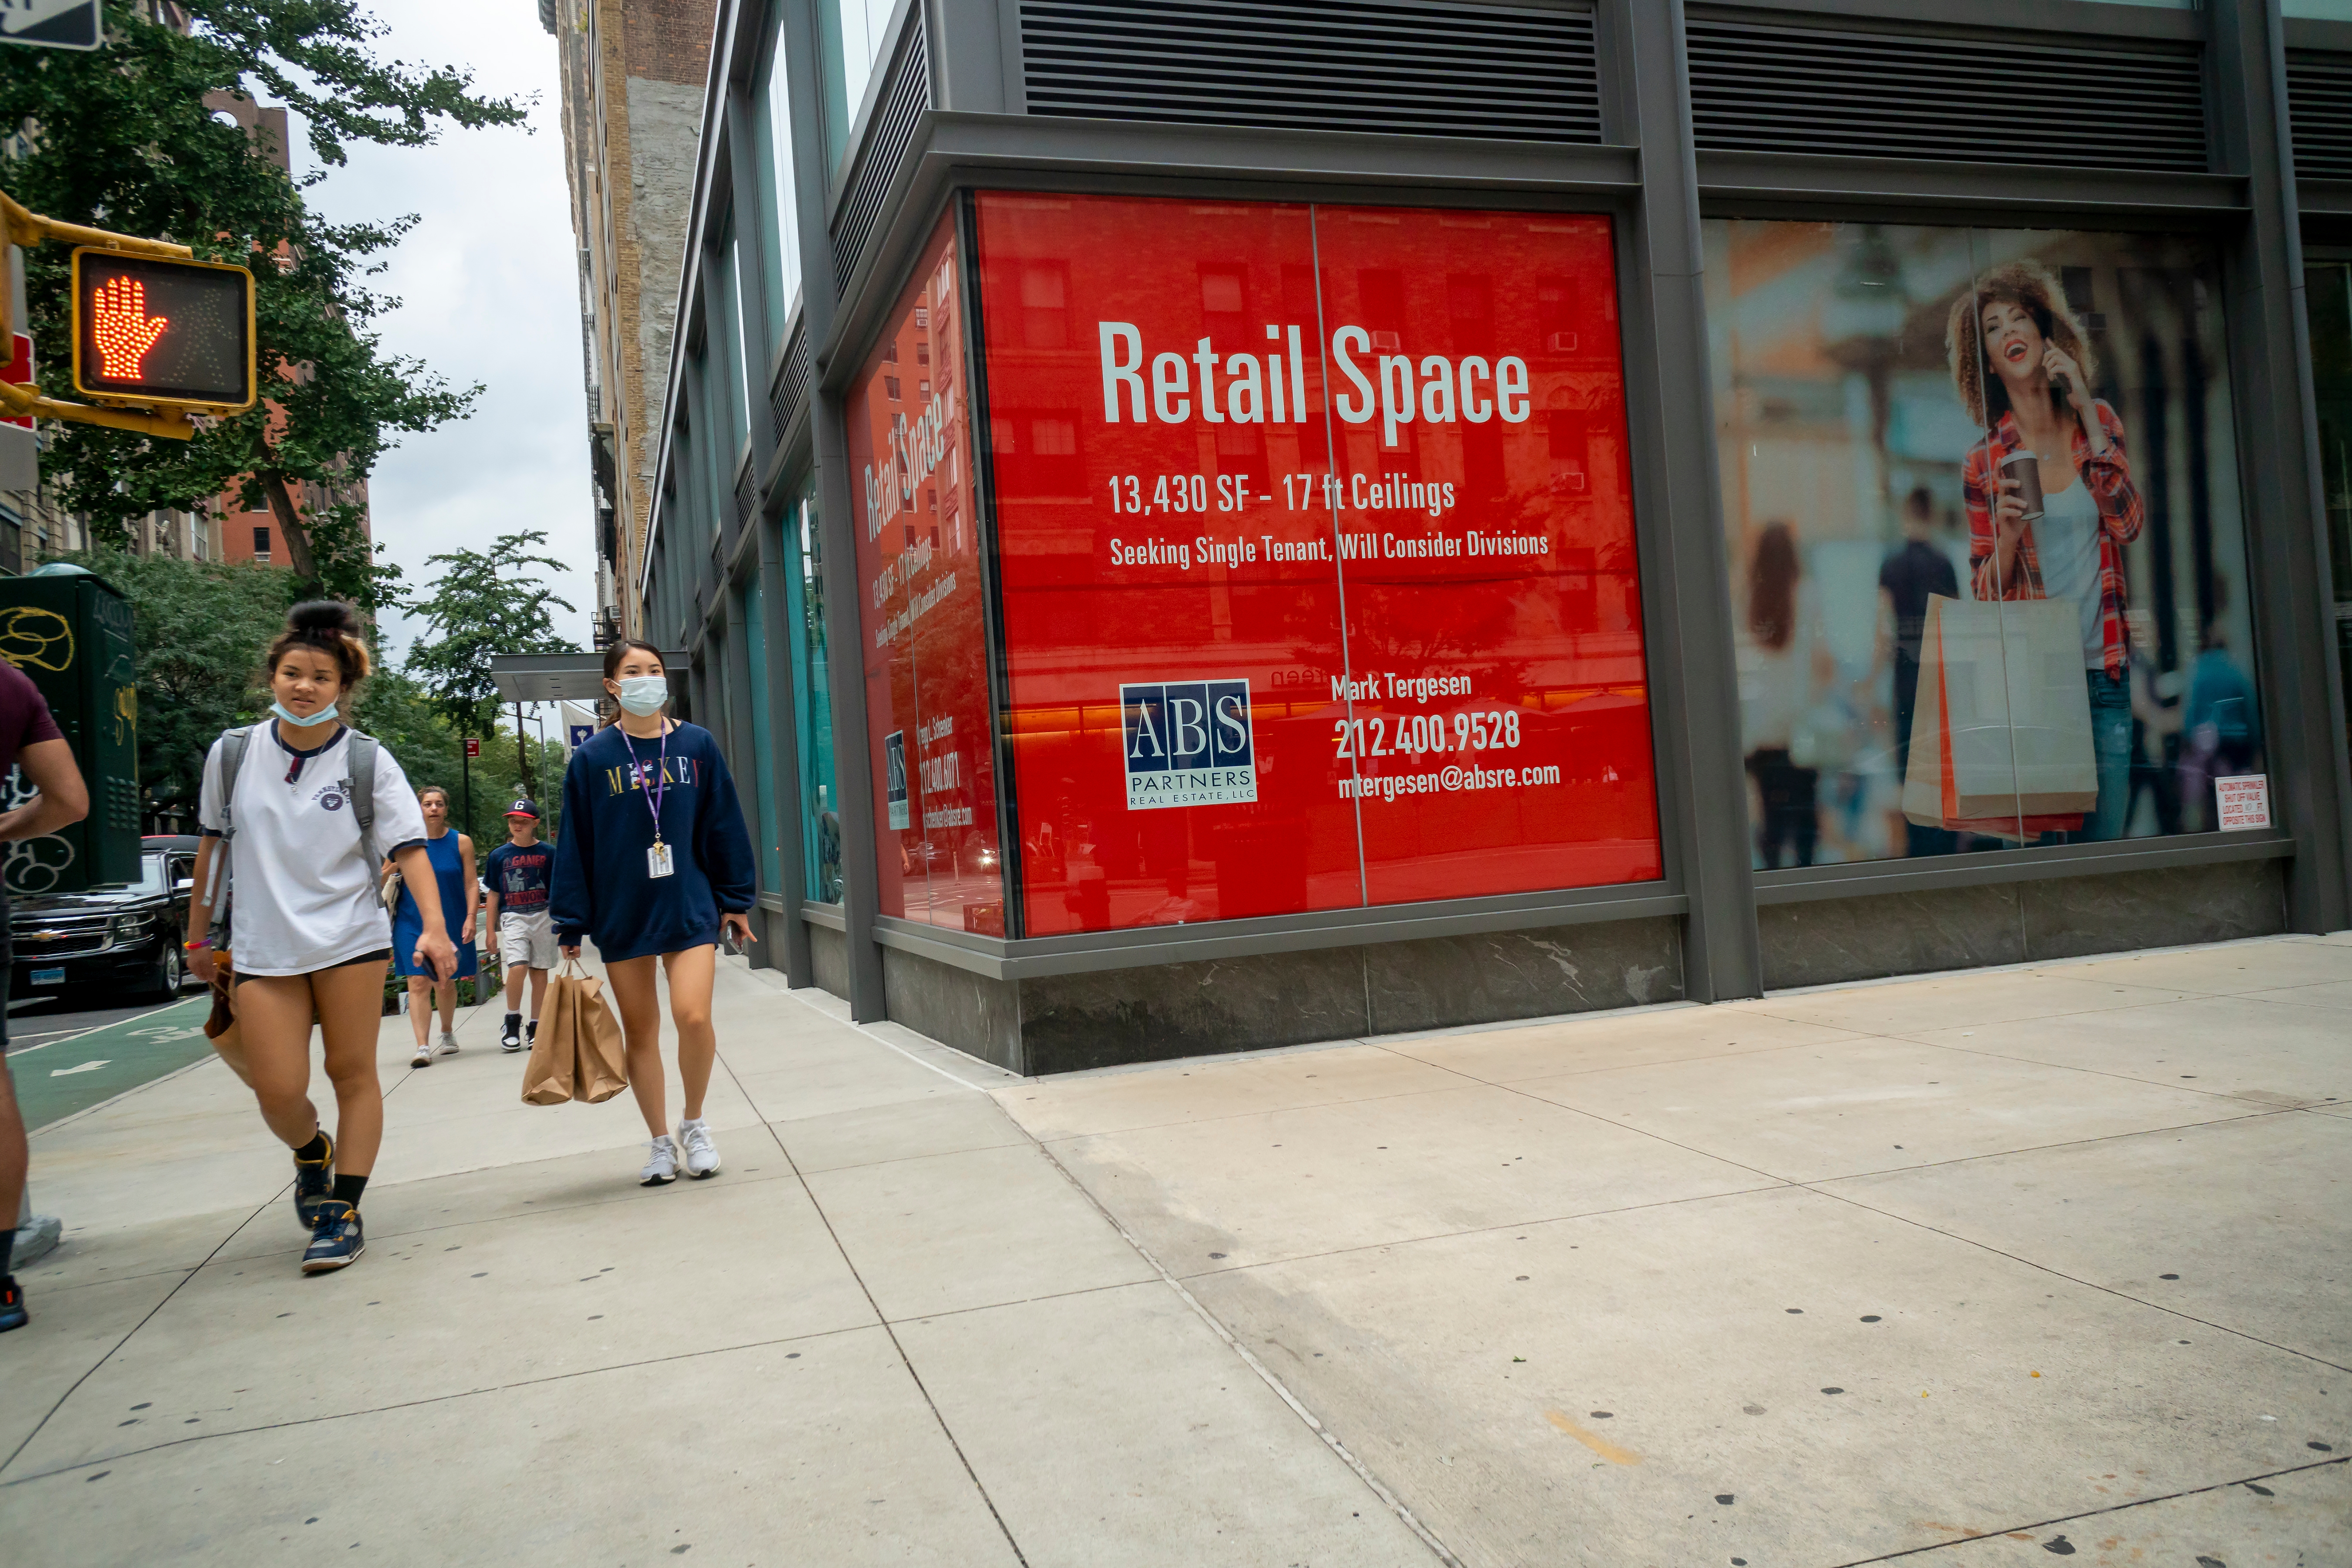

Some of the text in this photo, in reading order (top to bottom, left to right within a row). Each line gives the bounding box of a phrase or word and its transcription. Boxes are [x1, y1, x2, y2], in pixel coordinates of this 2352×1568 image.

[1099, 321, 1531, 447] Retail Space
[865, 392, 944, 543] Retail Space
[1109, 475, 1207, 516] 13,430
[1217, 474, 1249, 511] SF
[1283, 474, 1312, 510] 17
[1322, 473, 1345, 510] ft
[1352, 473, 1455, 517] Ceilings
[1110, 530, 1548, 570] Seeking Single Tenant, Will Consider Divisions
[1331, 672, 1471, 704] Mark Tergesen
[1130, 696, 1246, 758] ABS
[1335, 710, 1520, 759] 212.400.9528
[888, 744, 906, 791] ABS
[1132, 770, 1250, 792] PARTNERS
[1338, 764, 1560, 802] mtergesen@absre.com
[514, 801, 524, 810] G
[1131, 796, 1164, 805] REAL
[2237, 793, 2245, 801] OFF
